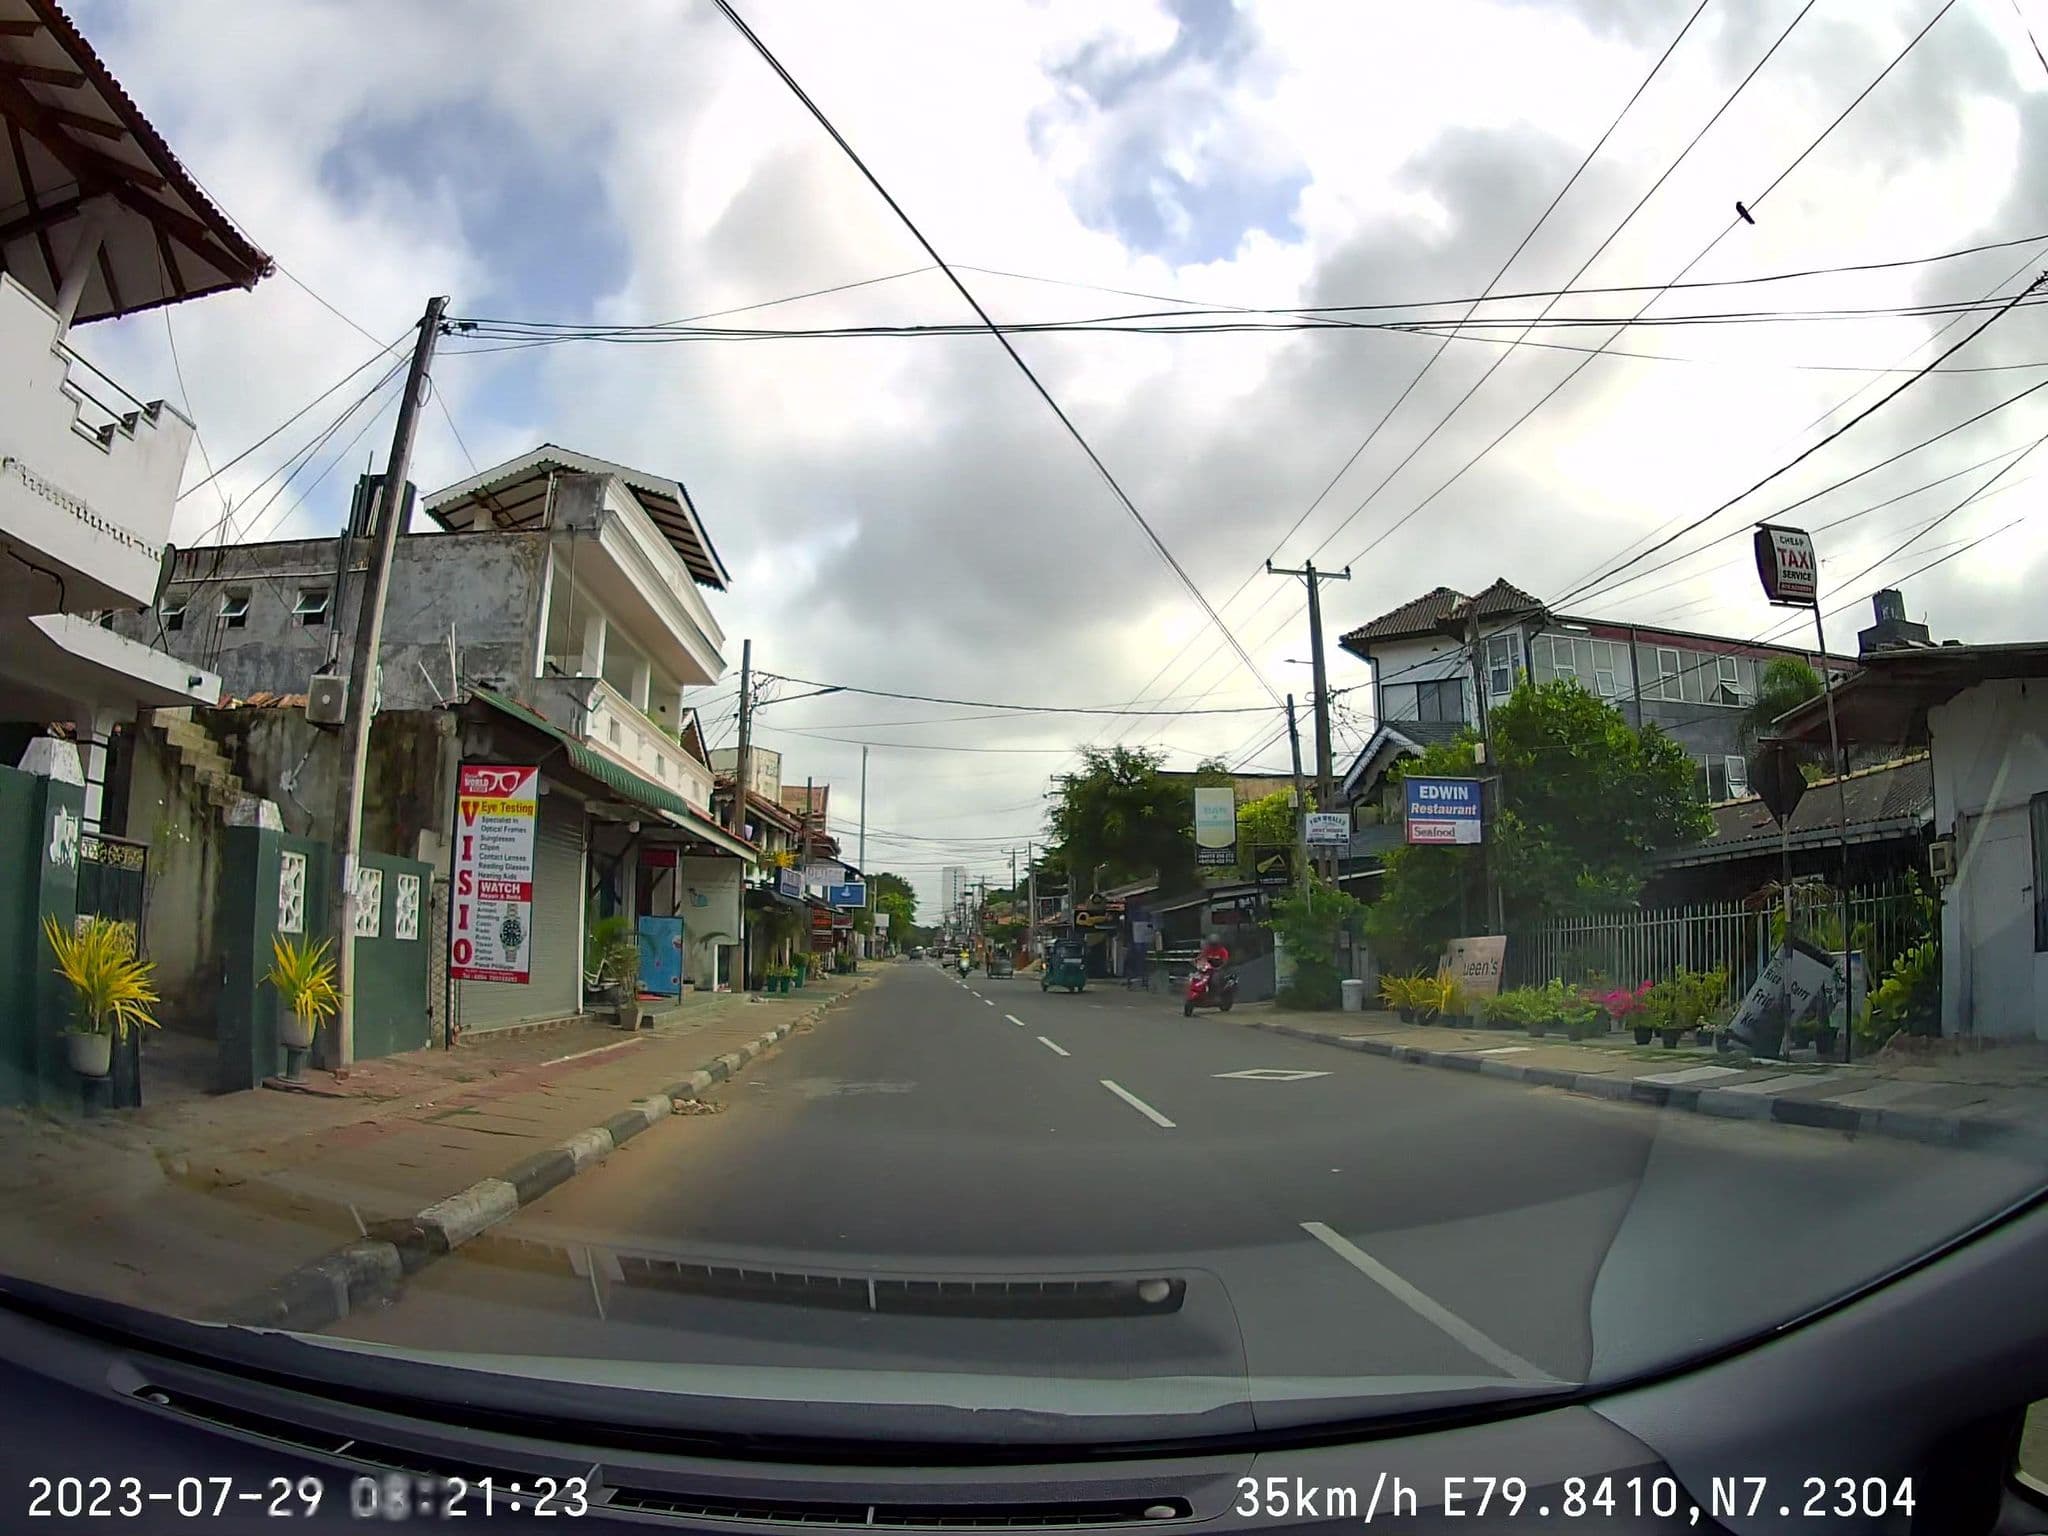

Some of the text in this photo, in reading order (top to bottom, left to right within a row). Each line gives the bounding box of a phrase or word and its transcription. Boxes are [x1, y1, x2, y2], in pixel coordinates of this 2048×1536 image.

[1779, 536, 1804, 547] CHEAP
[1777, 548, 1814, 570] TAXI
[1782, 570, 1811, 582] SERVICE
[1419, 785, 1468, 800] EDWIN
[481, 801, 534, 816] Eye Testing
[1411, 803, 1476, 815] Restaurant
[481, 825, 526, 834] Optical Frames
[1414, 826, 1456, 837] Seafood
[479, 853, 503, 861] Contact
[478, 862, 529, 871] Reading Glasses
[481, 882, 521, 894] WATCH
